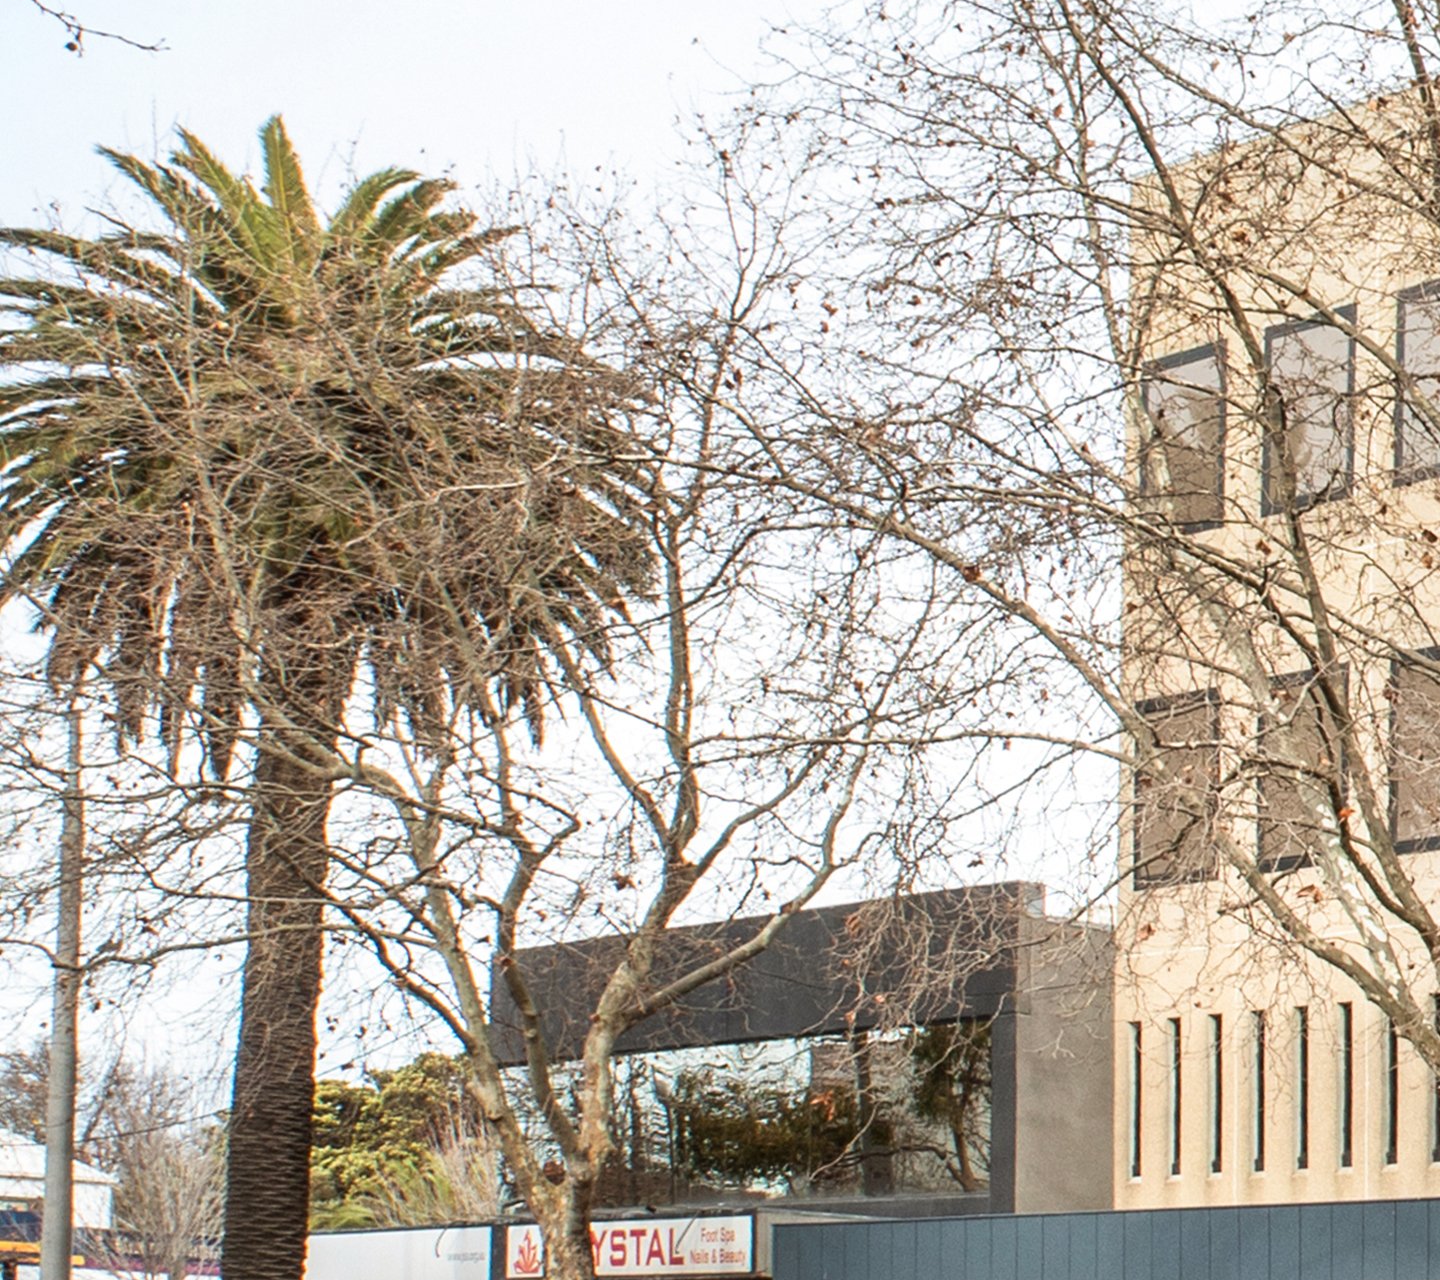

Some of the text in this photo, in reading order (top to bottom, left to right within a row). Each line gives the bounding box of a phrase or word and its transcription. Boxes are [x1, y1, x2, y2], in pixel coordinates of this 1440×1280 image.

[701, 1227, 735, 1245] Foot Spa
[590, 1228, 685, 1267] YSTAL
[690, 1250, 709, 1264] Nails
[720, 1248, 746, 1266] Beauty
